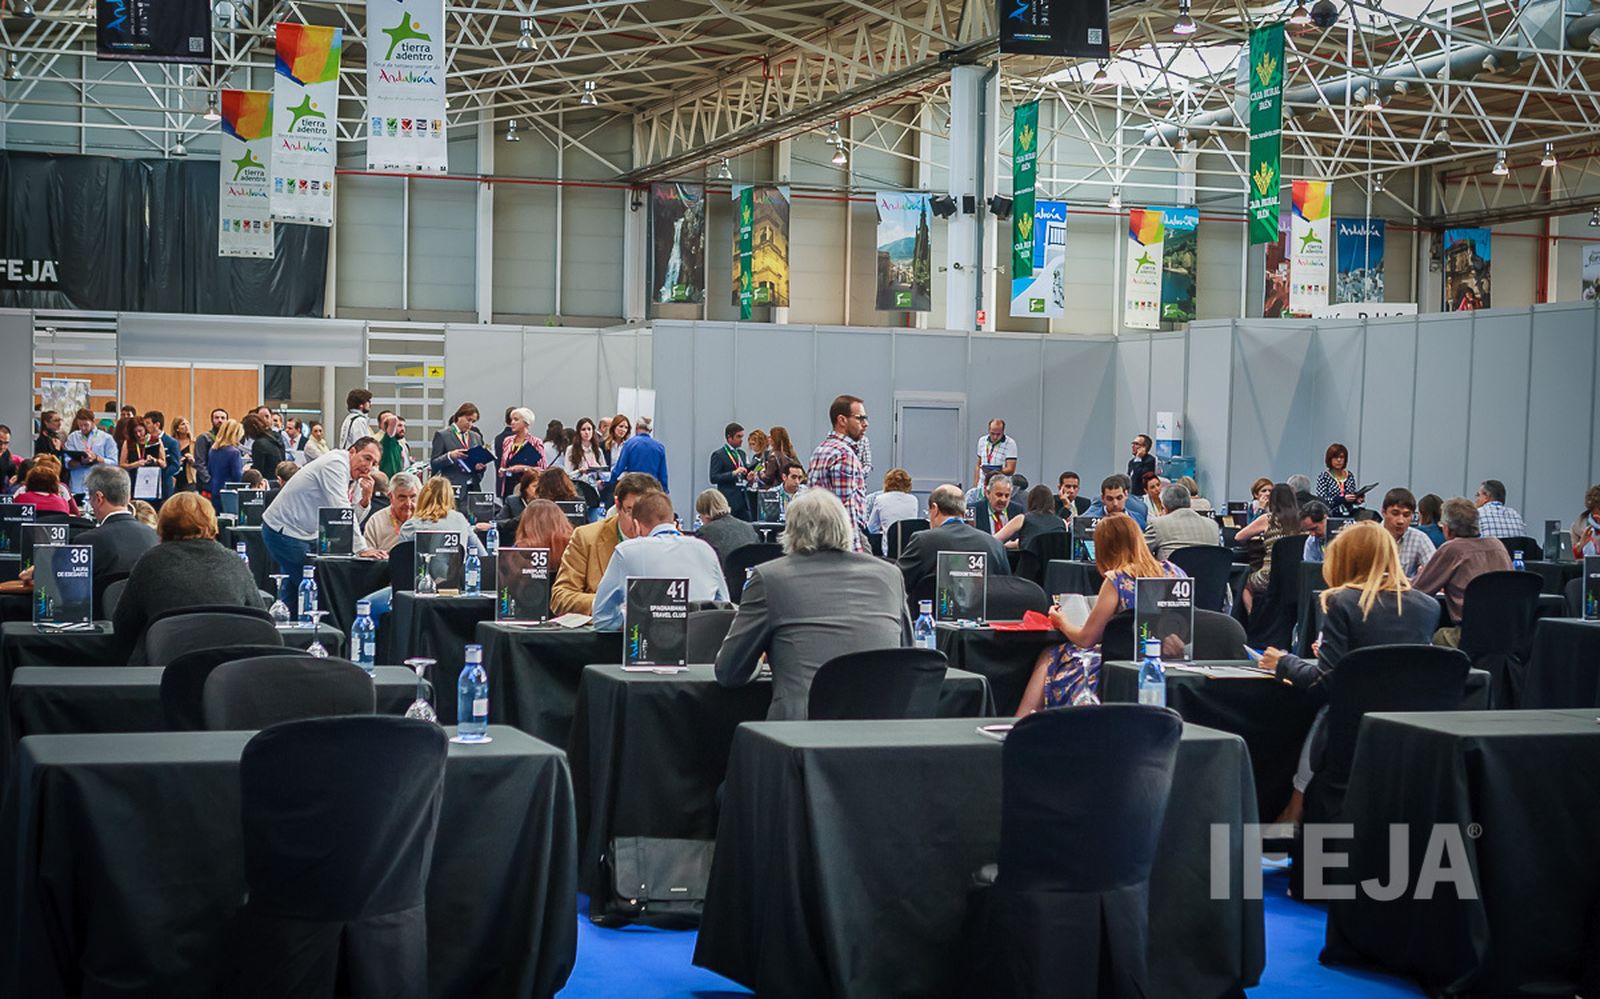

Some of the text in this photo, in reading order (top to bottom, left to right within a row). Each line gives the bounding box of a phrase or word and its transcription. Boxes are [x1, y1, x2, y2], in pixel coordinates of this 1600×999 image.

[402, 42, 431, 52] tierra
[396, 52, 434, 61] adentro
[379, 69, 437, 85] Andalucía
[302, 119, 325, 127] tierra
[297, 126, 328, 134] adentro
[21, 506, 34, 516] 24
[341, 509, 353, 520] 23
[51, 527, 66, 540] 30
[444, 534, 459, 546] 29
[70, 548, 89, 564] 36
[531, 552, 547, 566] 35
[968, 555, 984, 569] 34
[666, 581, 686, 599] 41
[1172, 581, 1190, 597] 40
